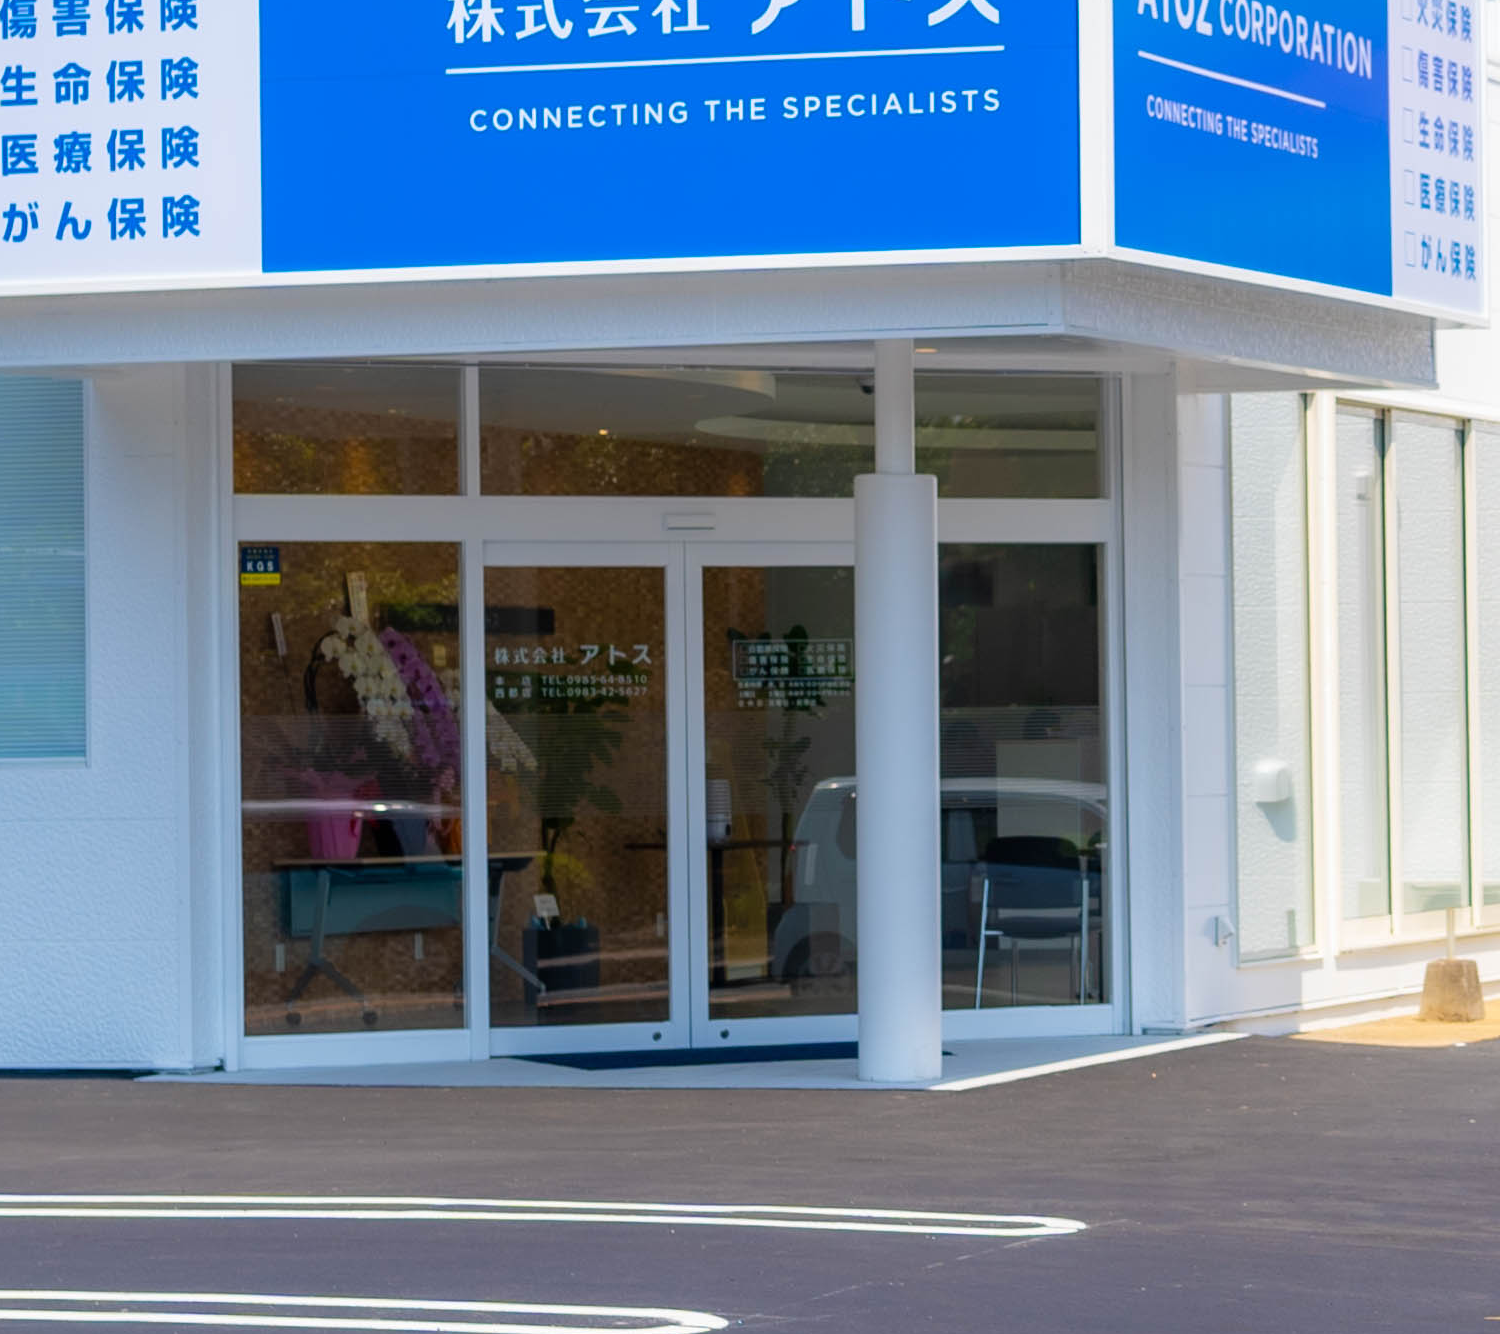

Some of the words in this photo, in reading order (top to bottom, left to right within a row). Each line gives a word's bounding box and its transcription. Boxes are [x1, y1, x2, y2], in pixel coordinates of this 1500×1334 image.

[0, 57, 198, 106] 生命保険
[470, 102, 687, 131] CONNECTING
[705, 99, 765, 121] THE
[784, 89, 999, 118] SPECIALISTS
[1147, 95, 1223, 135] CONNECTING
[1226, 116, 1248, 142] THE
[1251, 123, 1318, 158] SPECIALISTS
[2, 126, 199, 176] 医療保険
[3, 195, 200, 242] がん保険
[1421, 234, 1476, 281] がん保険
[494, 646, 566, 665] 株式会社
[580, 644, 652, 666] アトス
